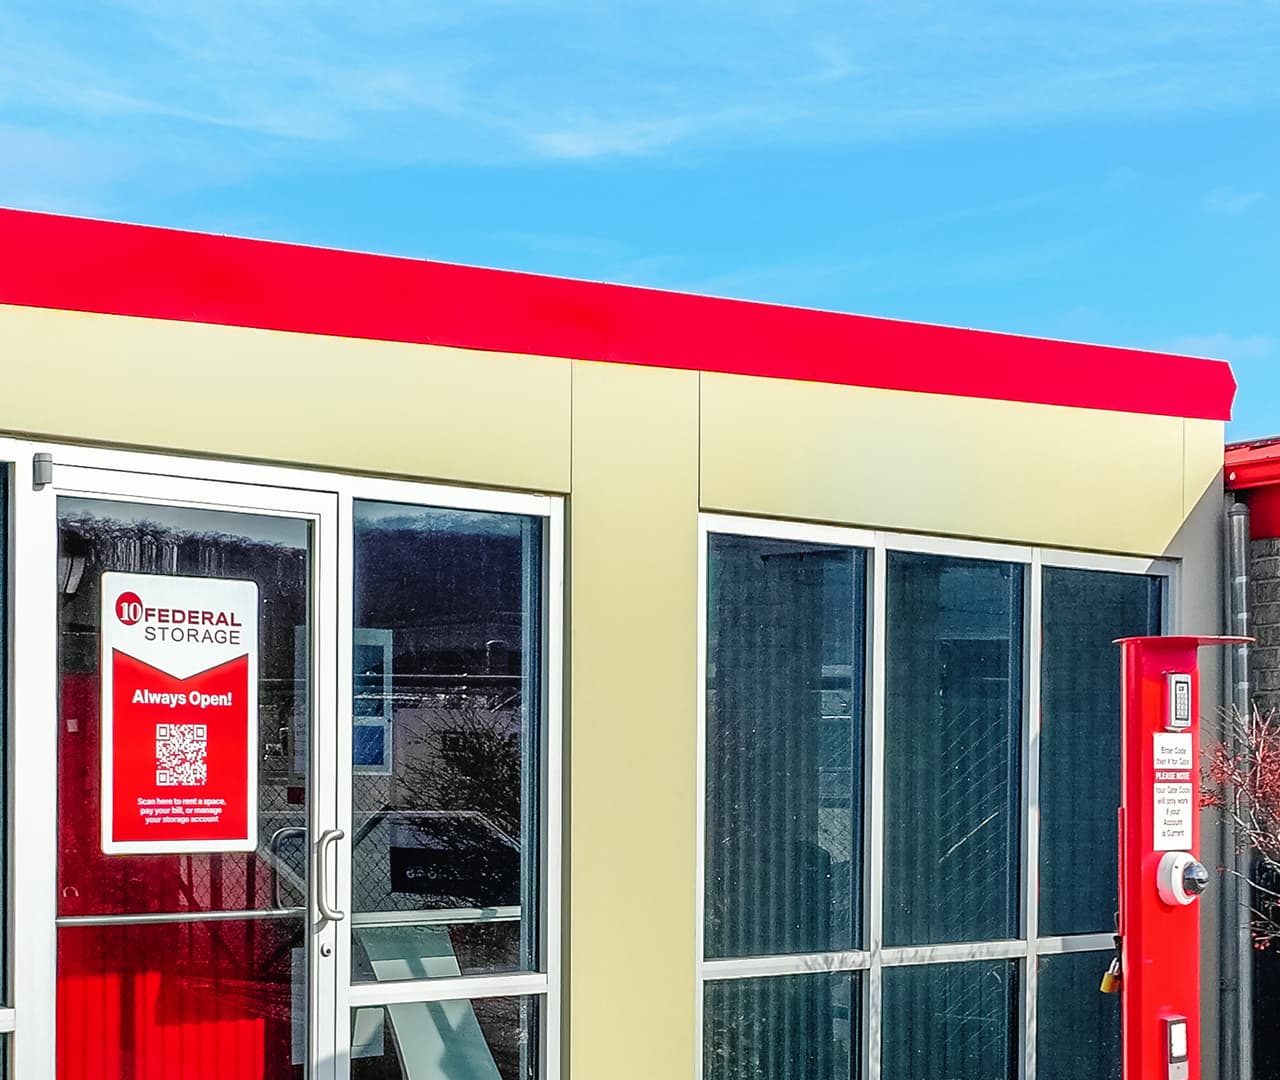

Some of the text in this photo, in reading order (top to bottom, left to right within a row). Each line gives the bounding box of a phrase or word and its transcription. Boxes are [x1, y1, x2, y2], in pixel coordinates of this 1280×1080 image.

[120, 601, 242, 627] 10 FEDERAL
[145, 626, 241, 645] STORAGE
[132, 689, 233, 709] Always Open!
[137, 797, 155, 805] Scan
[156, 797, 173, 805] here
[140, 807, 154, 816] pay
[154, 807, 170, 816] your
[194, 807, 222, 816] manage
[145, 815, 219, 825] your storage account
